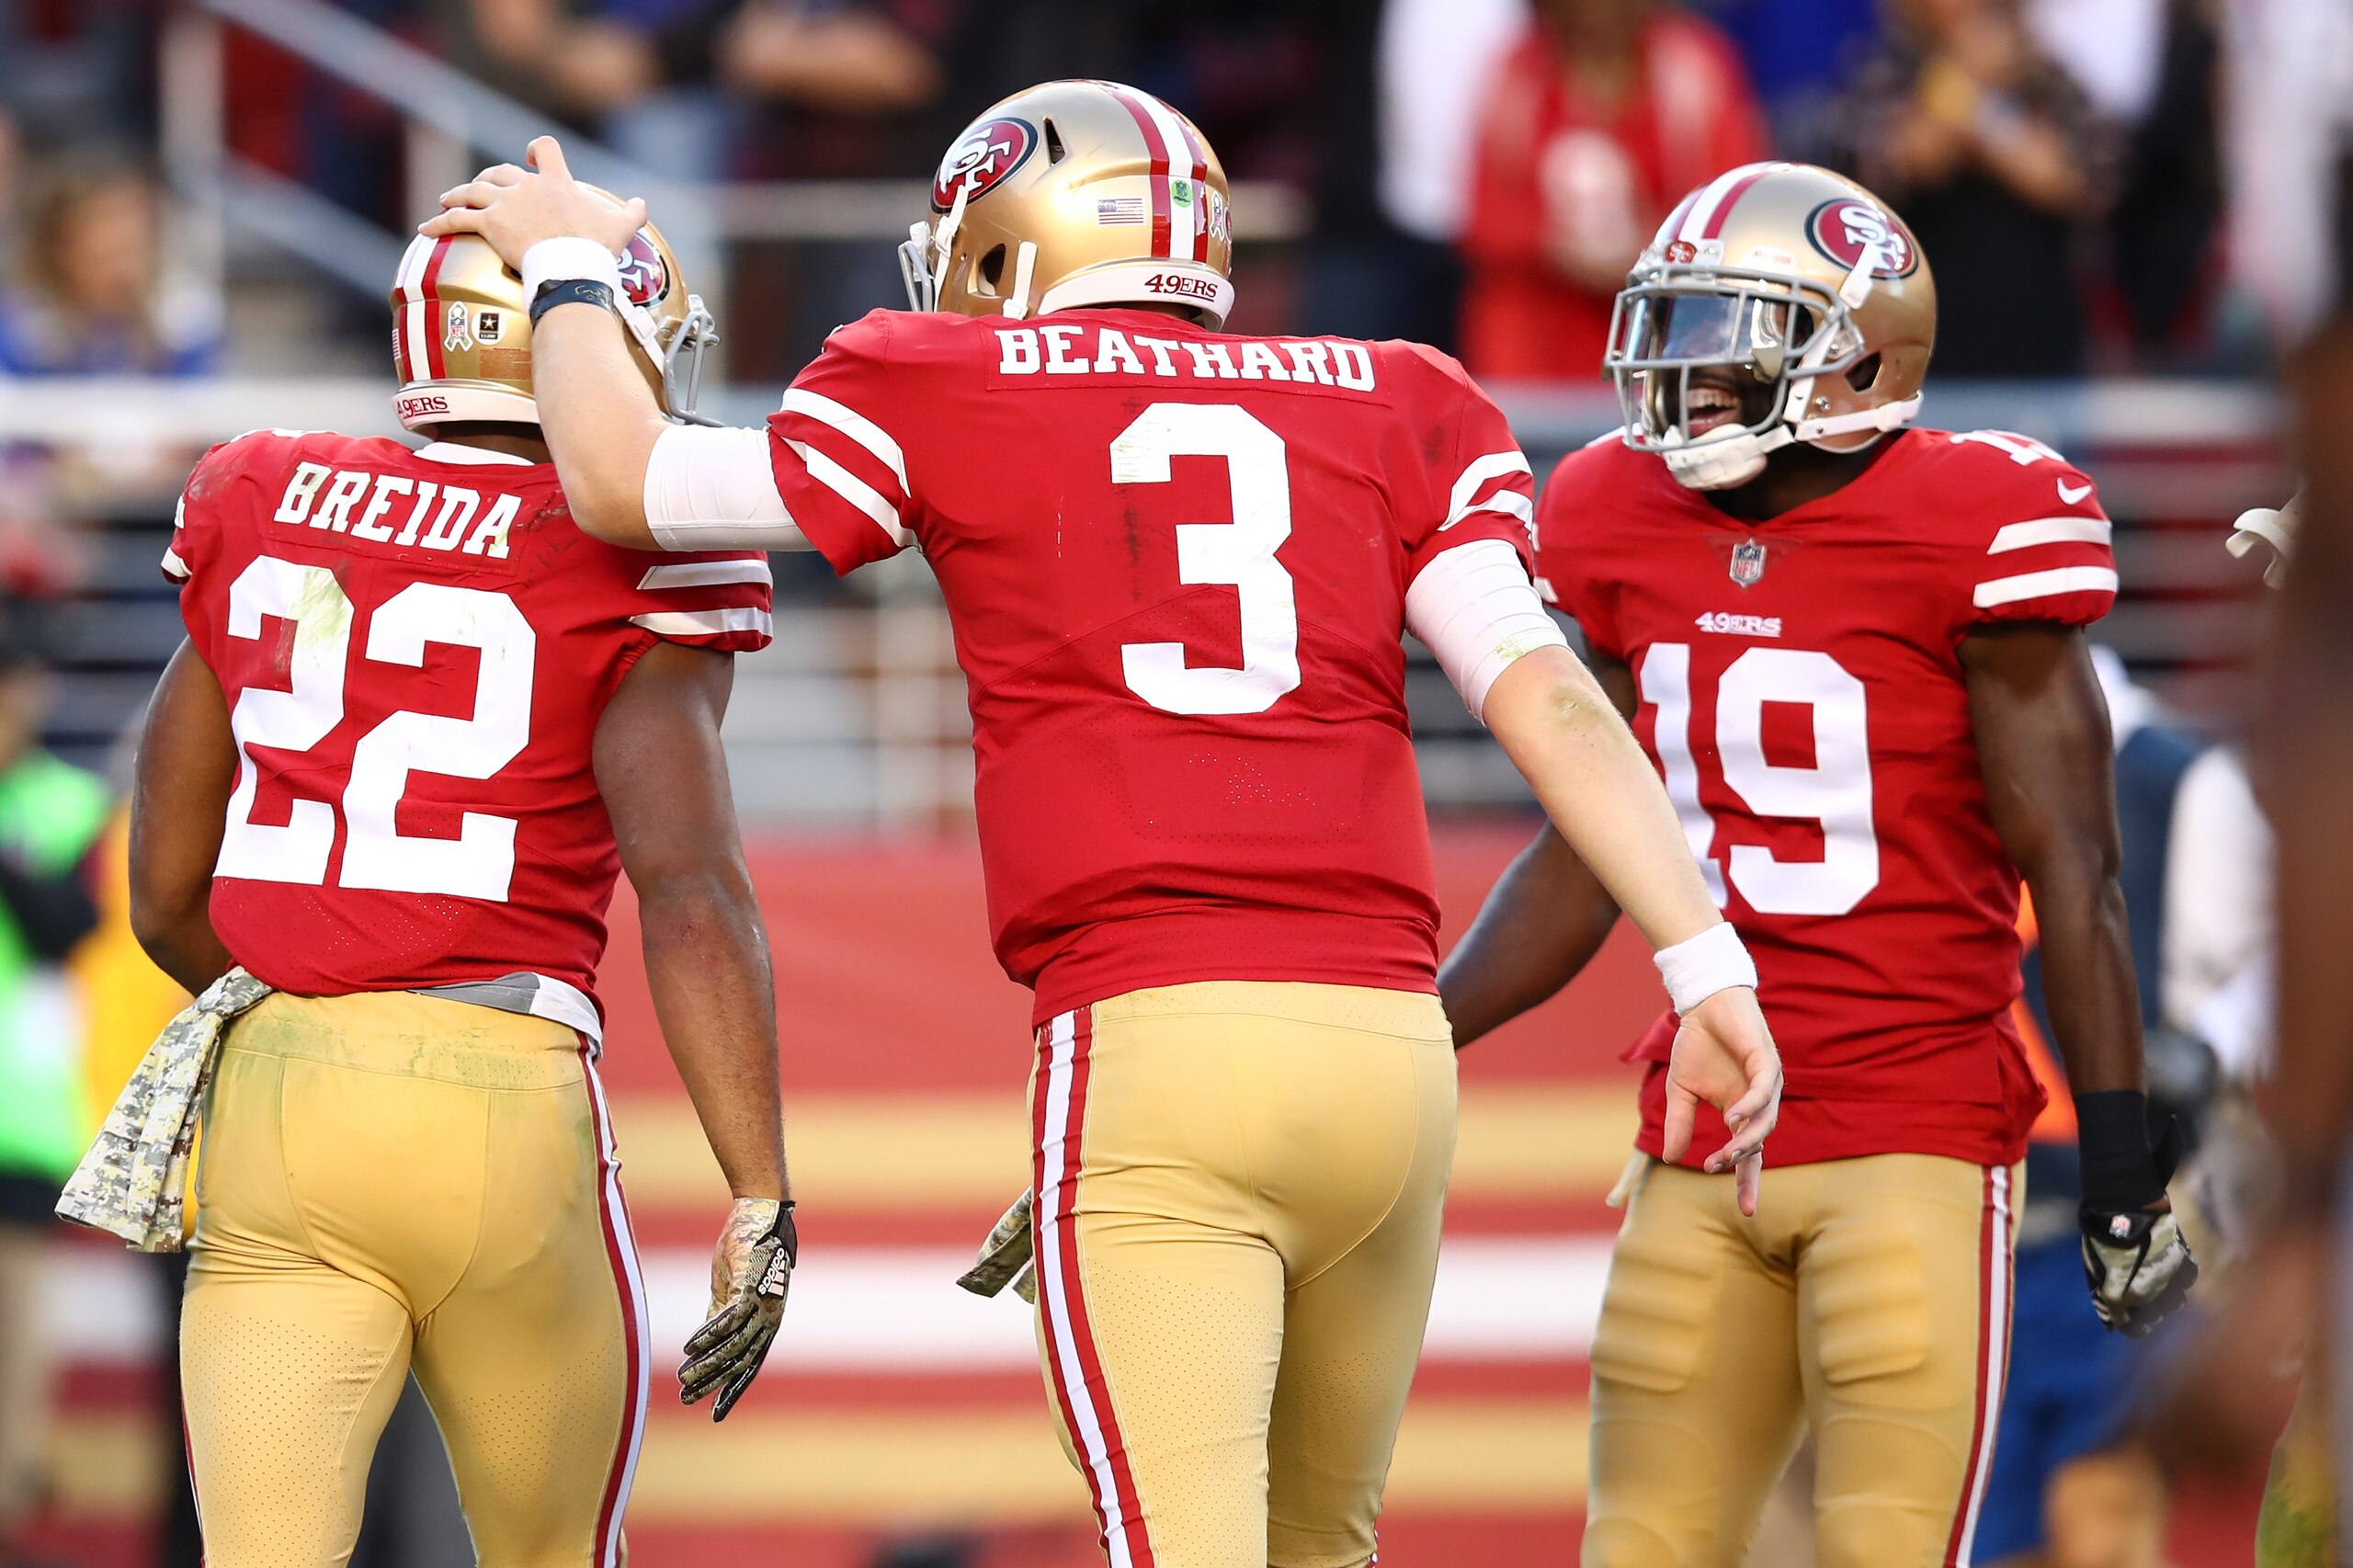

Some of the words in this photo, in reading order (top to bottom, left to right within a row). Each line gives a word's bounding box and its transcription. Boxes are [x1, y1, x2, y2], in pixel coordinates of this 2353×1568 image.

[1144, 274, 1218, 302] 49ERS
[995, 325, 1377, 392] BEATHARD
[396, 396, 450, 419] 49ERS
[273, 460, 523, 559] BREIDA
[1109, 402, 1302, 716] 3
[1694, 611, 1782, 638] 49ERS
[212, 554, 537, 903] 22
[1640, 642, 1881, 916] 19
[758, 1247, 786, 1295] adidas
